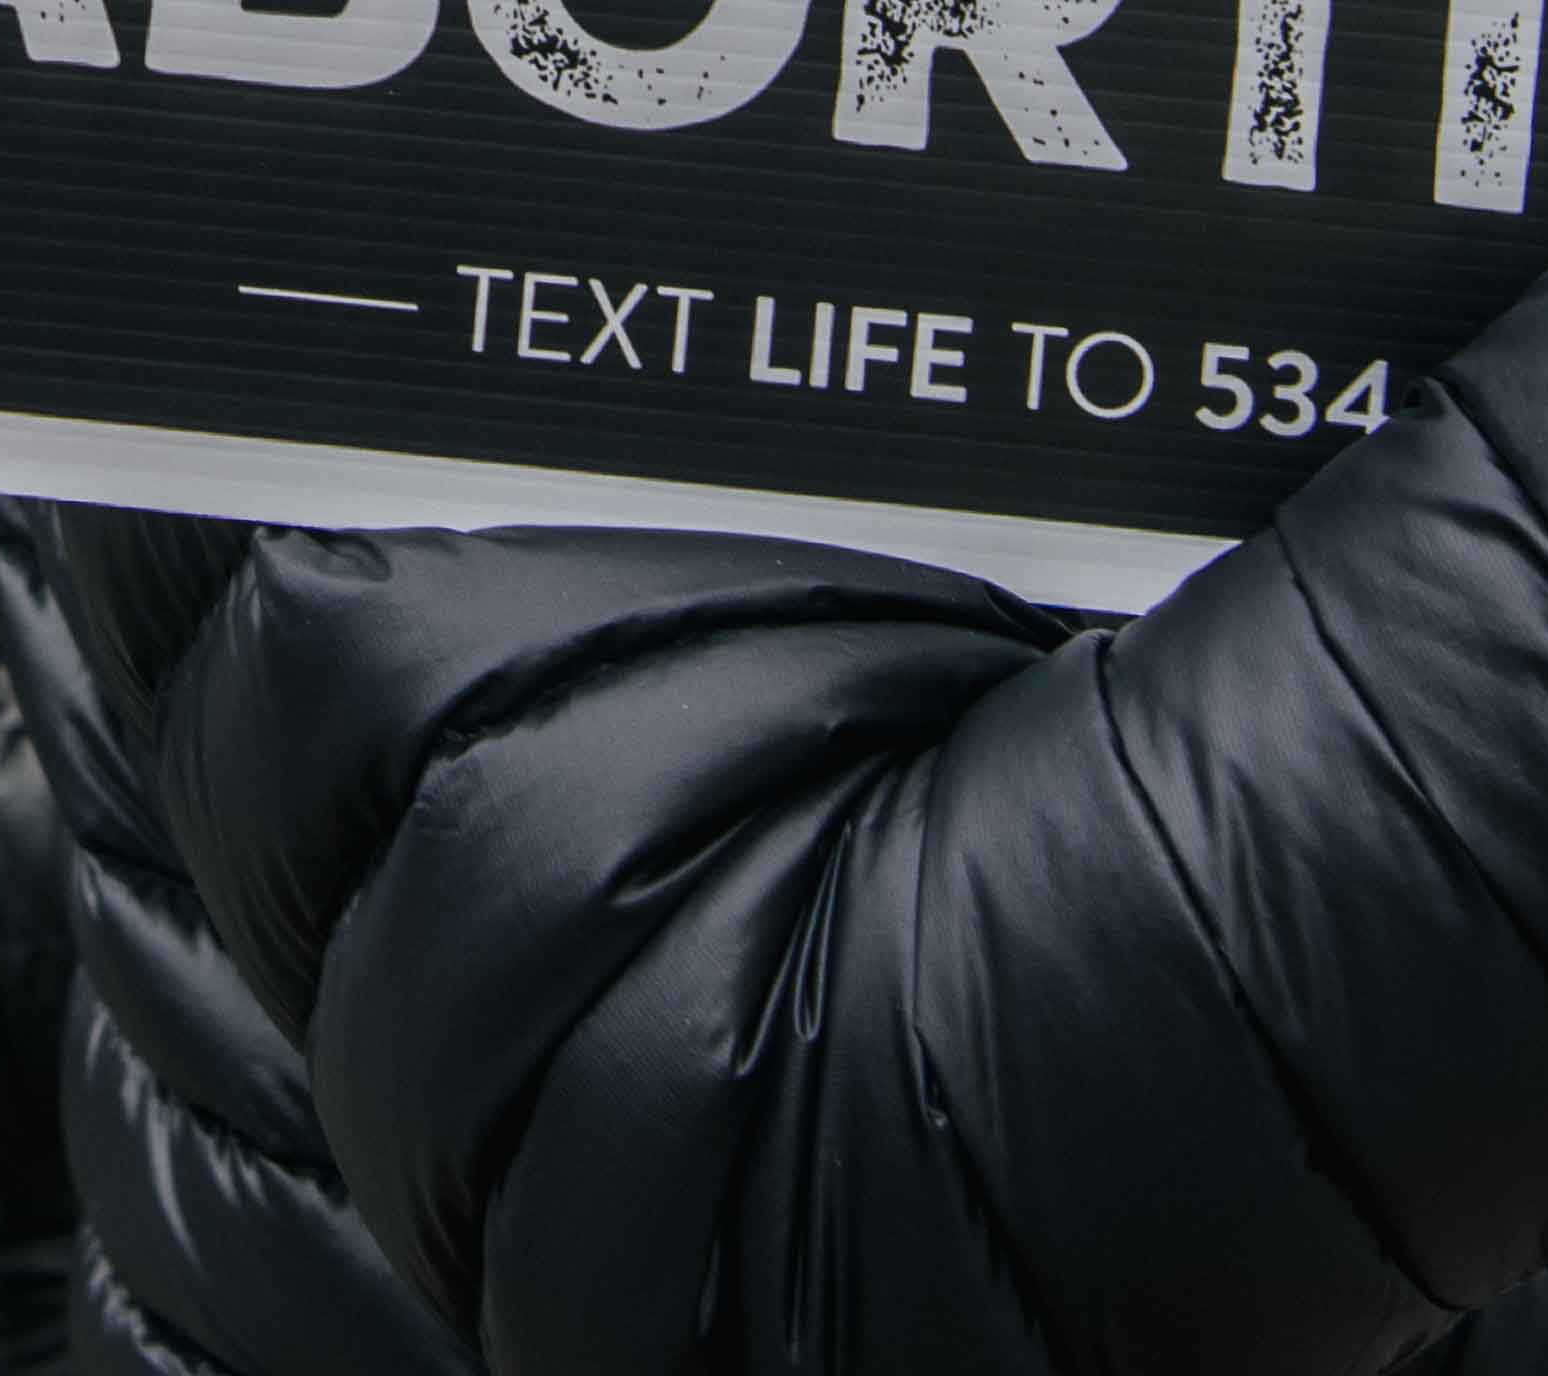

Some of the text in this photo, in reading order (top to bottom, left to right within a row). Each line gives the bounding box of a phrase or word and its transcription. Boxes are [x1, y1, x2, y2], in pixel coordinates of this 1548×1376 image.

[456, 264, 714, 375] TEXT
[749, 295, 974, 404] LIFE
[1011, 322, 1155, 420] TO
